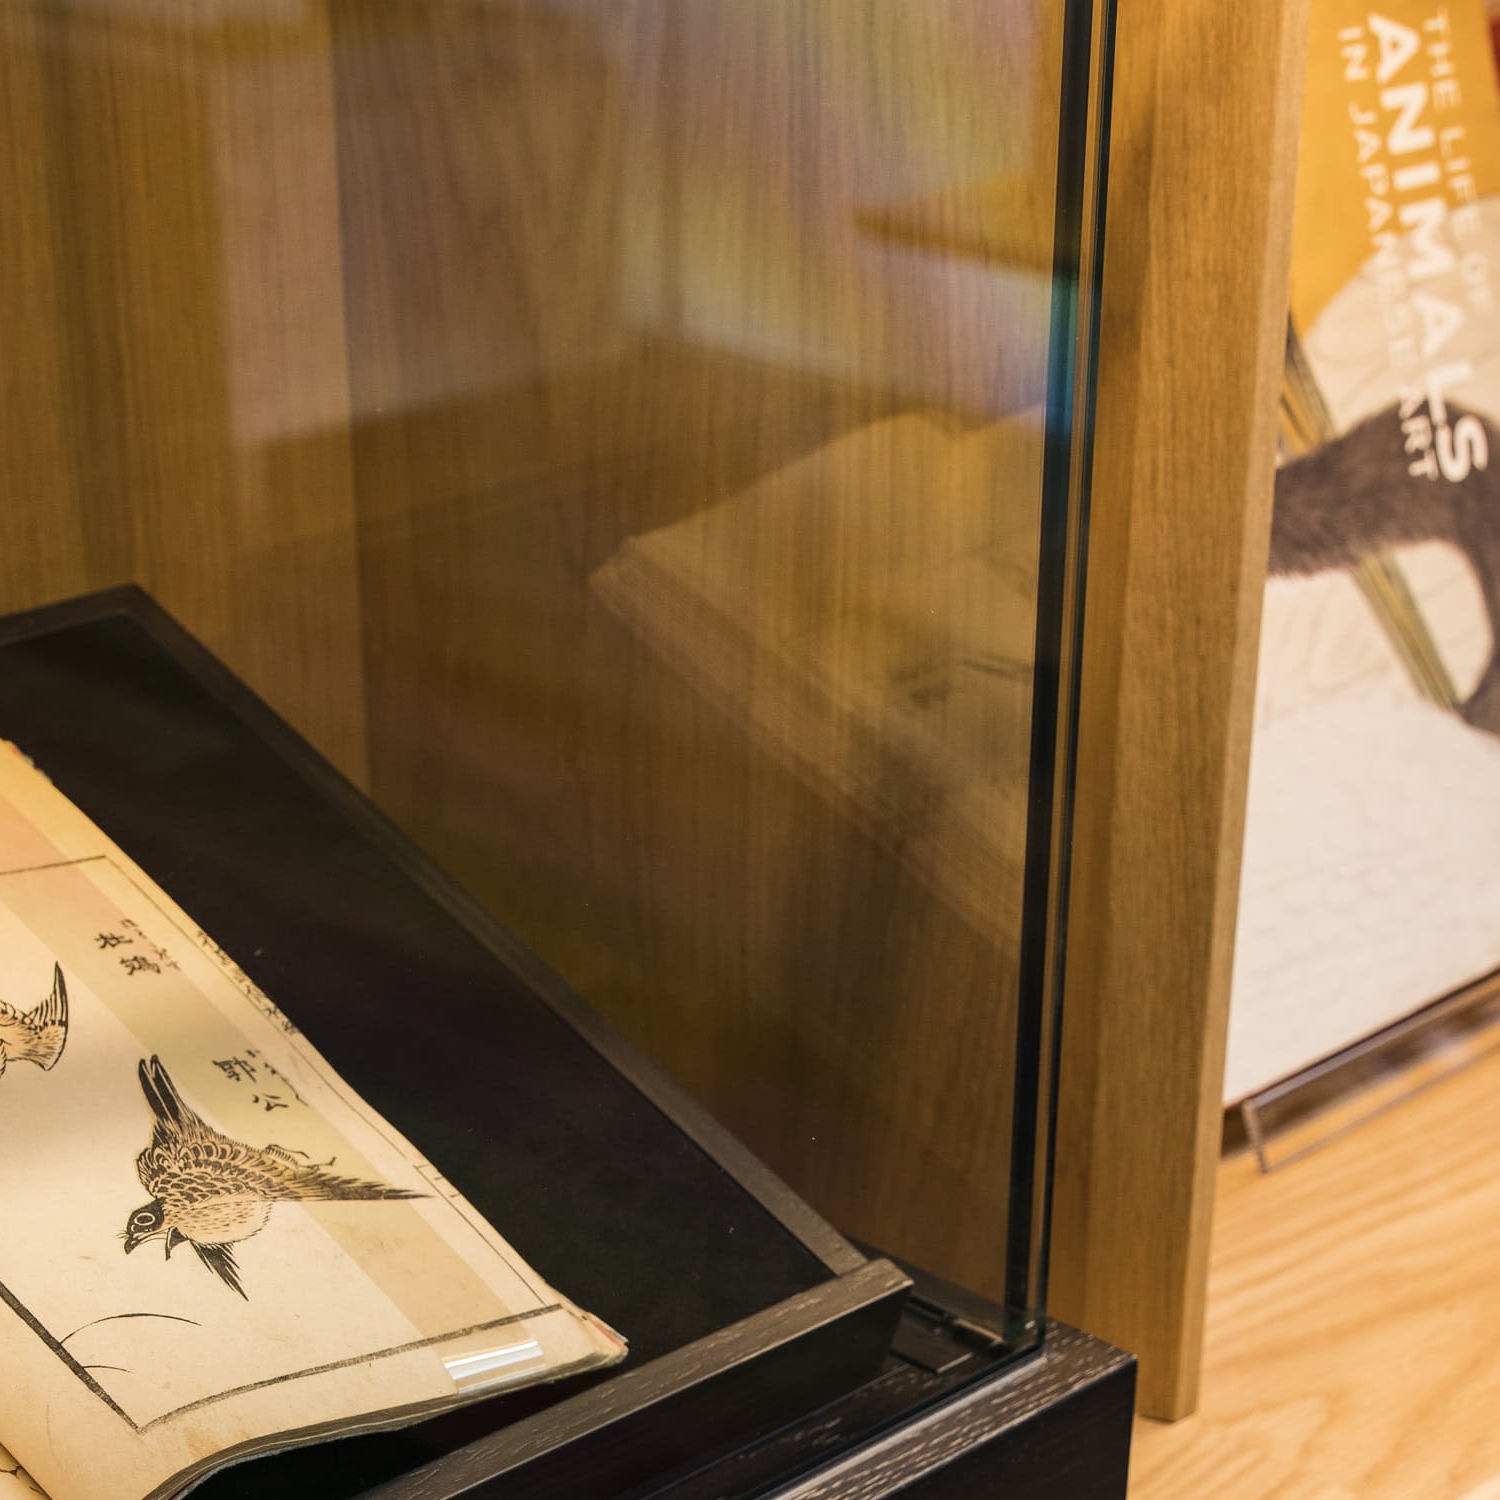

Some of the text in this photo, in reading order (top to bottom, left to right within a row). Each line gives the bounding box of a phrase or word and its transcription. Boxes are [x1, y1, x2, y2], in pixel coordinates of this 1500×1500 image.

[1337, 26, 1439, 481] IN JAPANESE ART
[1367, 12, 1488, 483] ANIMALS
[1422, 8, 1495, 313] THE LIFE OF
